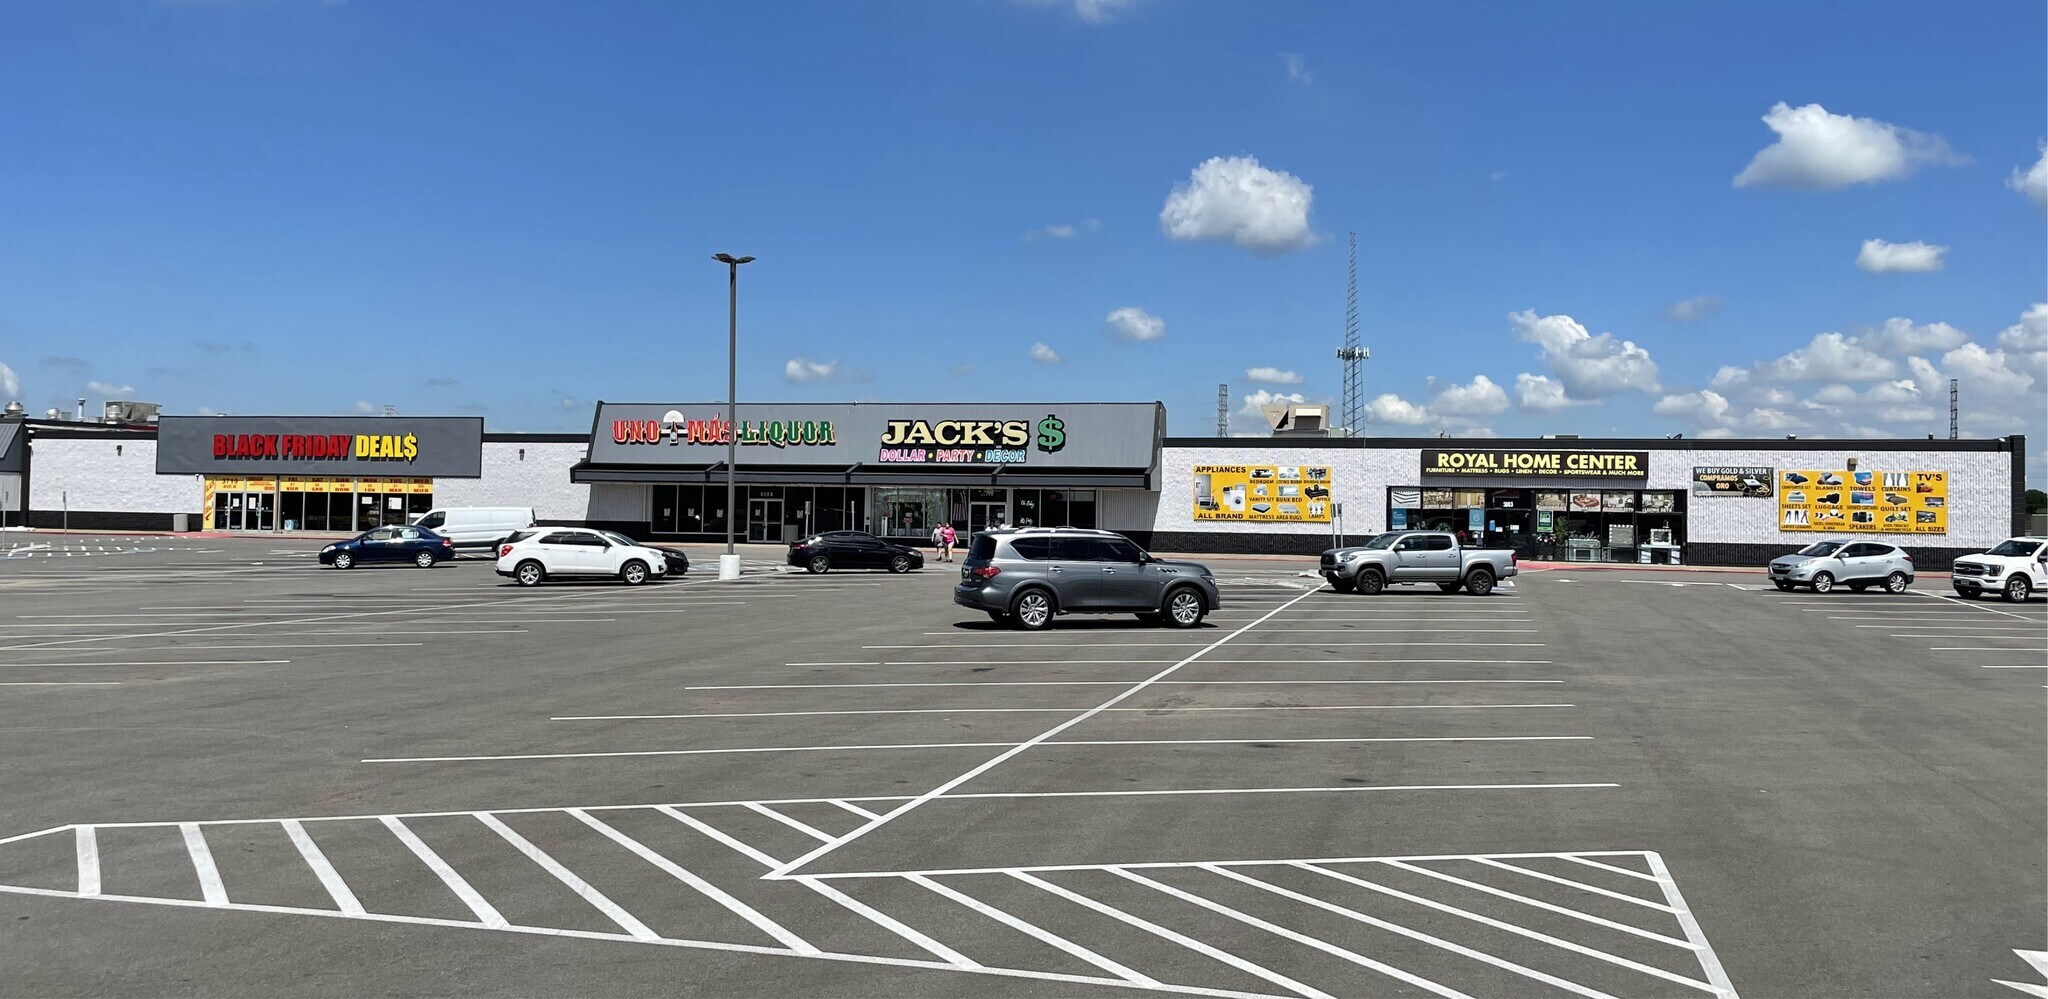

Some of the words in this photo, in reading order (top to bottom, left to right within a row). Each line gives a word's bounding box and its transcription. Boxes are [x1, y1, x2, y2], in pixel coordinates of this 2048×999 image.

[213, 434, 279, 459] BLACK
[281, 434, 352, 459] FRIDAY
[355, 432, 418, 462] DEAL$
[613, 420, 660, 443] UNO
[741, 420, 837, 448] LIQUOR
[881, 421, 988, 445] JACK'S
[1038, 416, 1065, 451] $
[880, 449, 926, 462] DOLLAR
[936, 449, 975, 462] PARTY
[1438, 453, 1498, 468] ROYAL
[1504, 454, 1561, 469] HOME
[1567, 455, 1637, 470] CENTER
